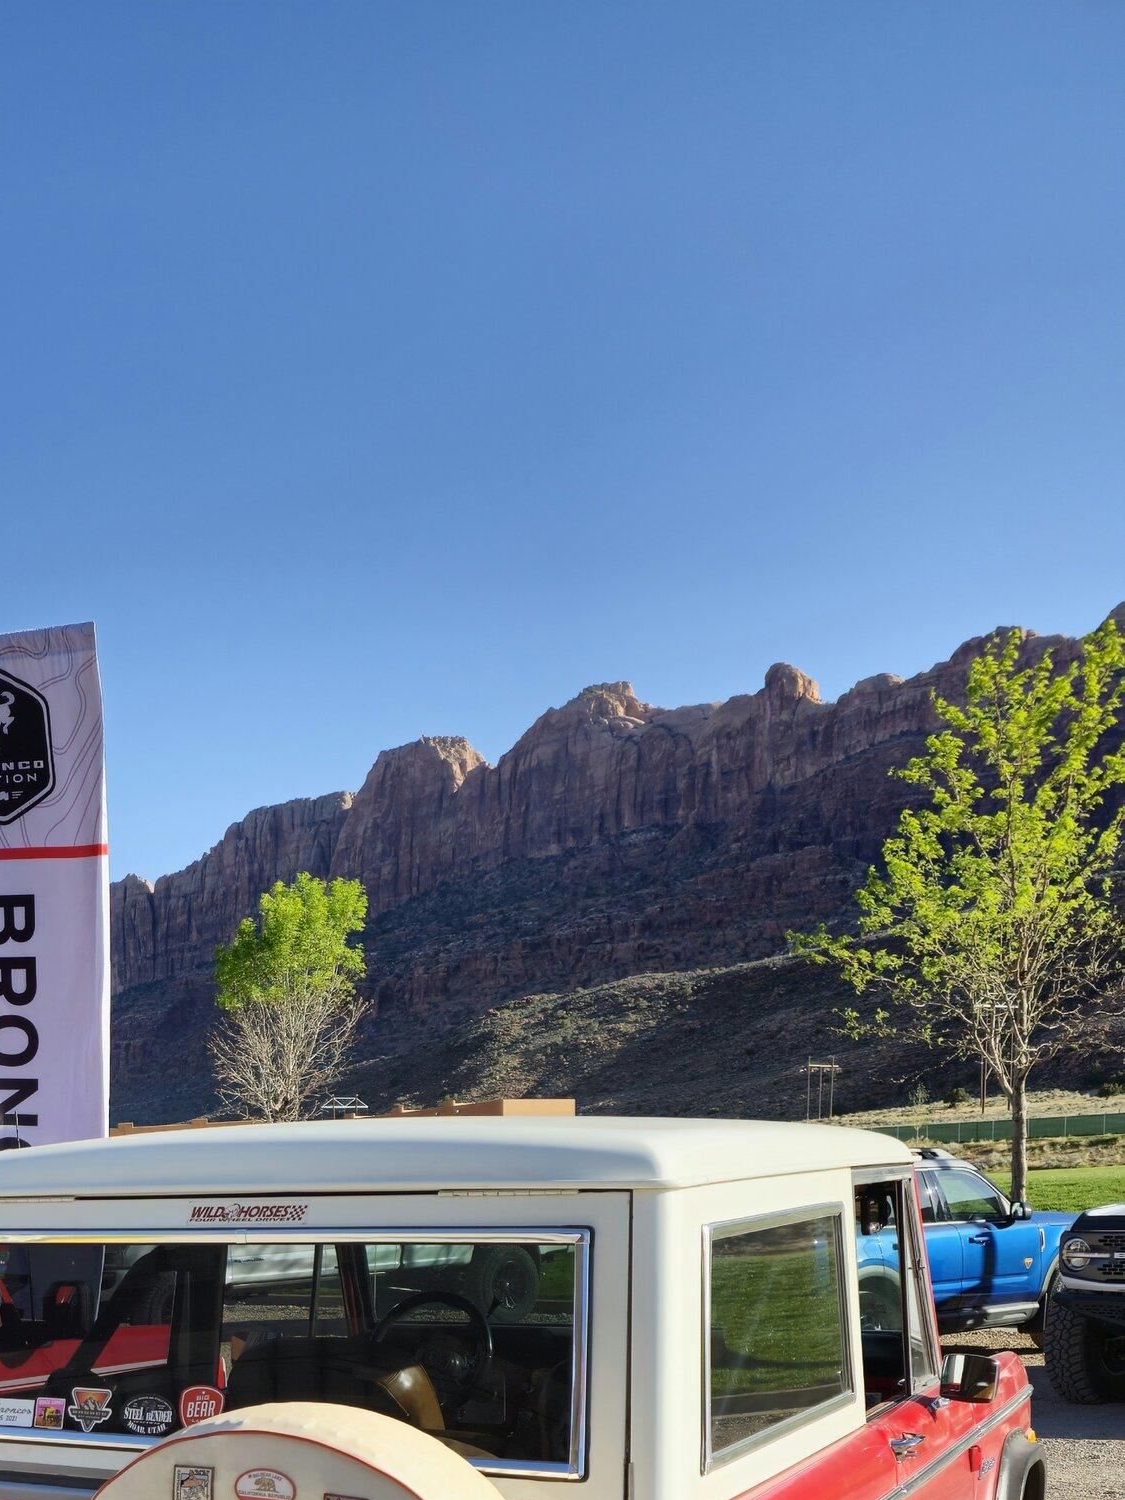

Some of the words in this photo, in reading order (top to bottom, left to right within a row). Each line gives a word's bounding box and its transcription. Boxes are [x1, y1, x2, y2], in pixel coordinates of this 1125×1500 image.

[191, 1206, 226, 1218] WILD
[238, 1205, 292, 1218] HORSES
[124, 1404, 144, 1421] STEEL
[146, 1409, 172, 1423] BENDER
[187, 1401, 216, 1418] BEAR
